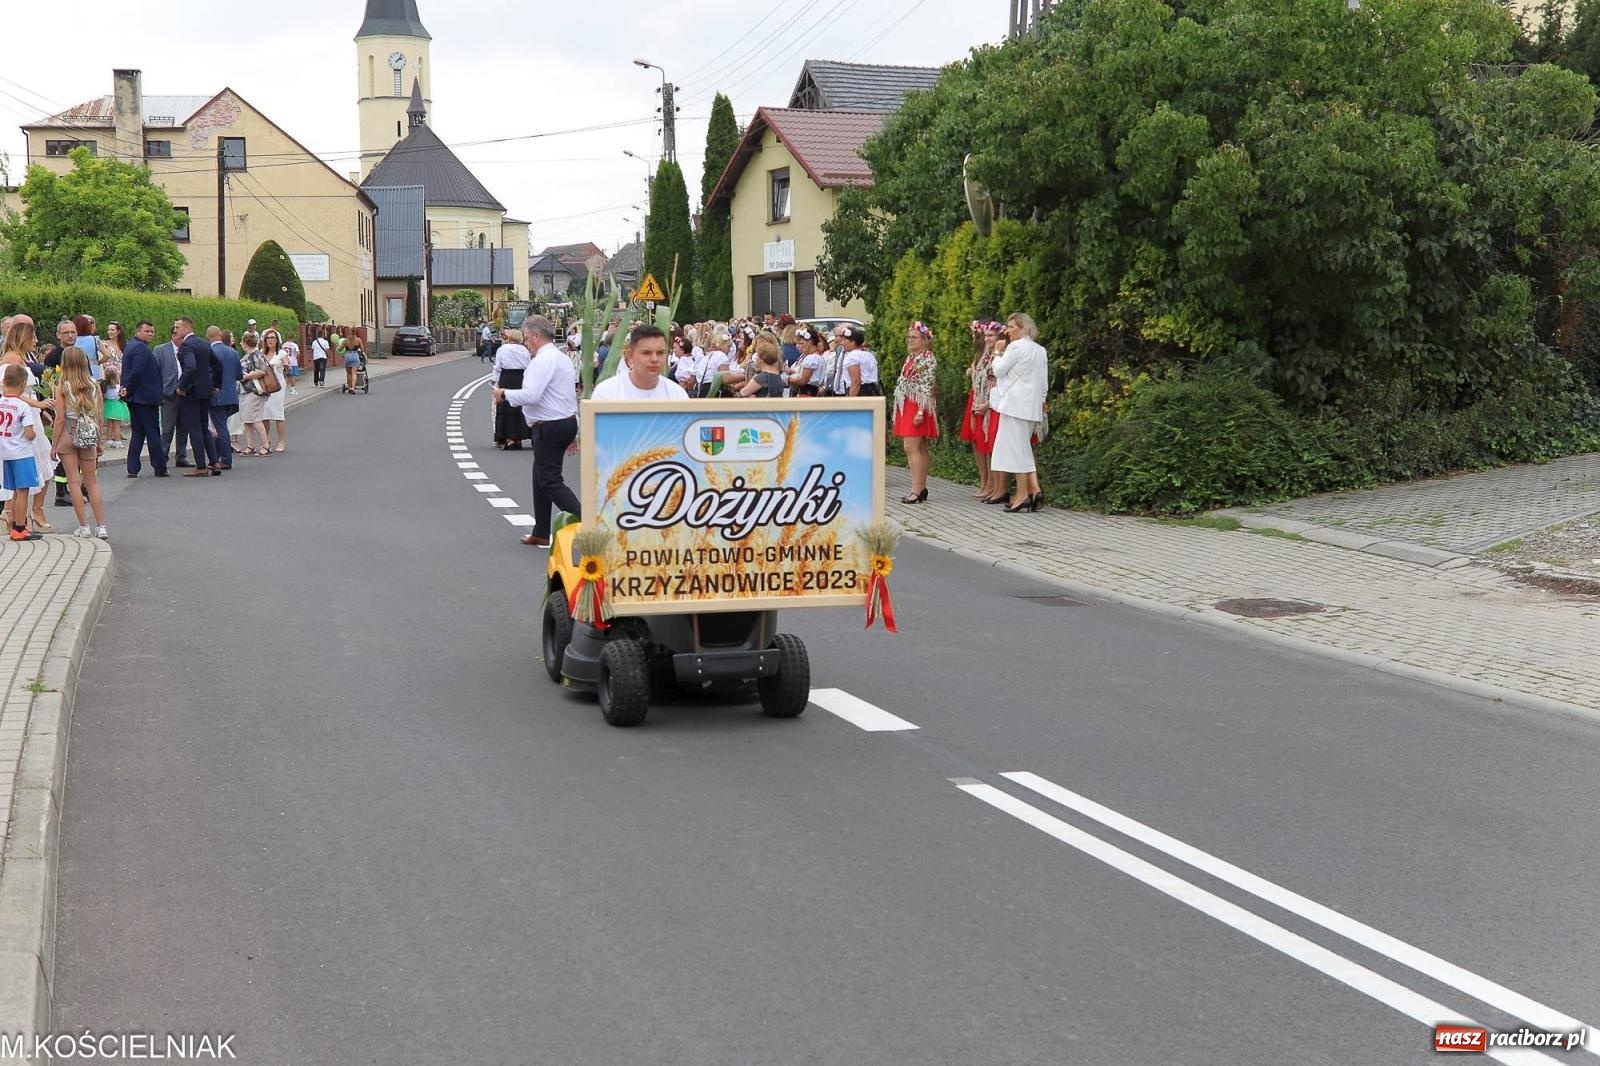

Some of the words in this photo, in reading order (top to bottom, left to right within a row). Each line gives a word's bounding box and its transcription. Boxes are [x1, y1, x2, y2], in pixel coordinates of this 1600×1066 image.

[617, 461, 845, 541] Dożynki
[626, 544, 843, 567] POWIATOWO-GMINNE
[611, 568, 795, 597] KRZYŻANOWICE
[802, 570, 857, 590] 2023
